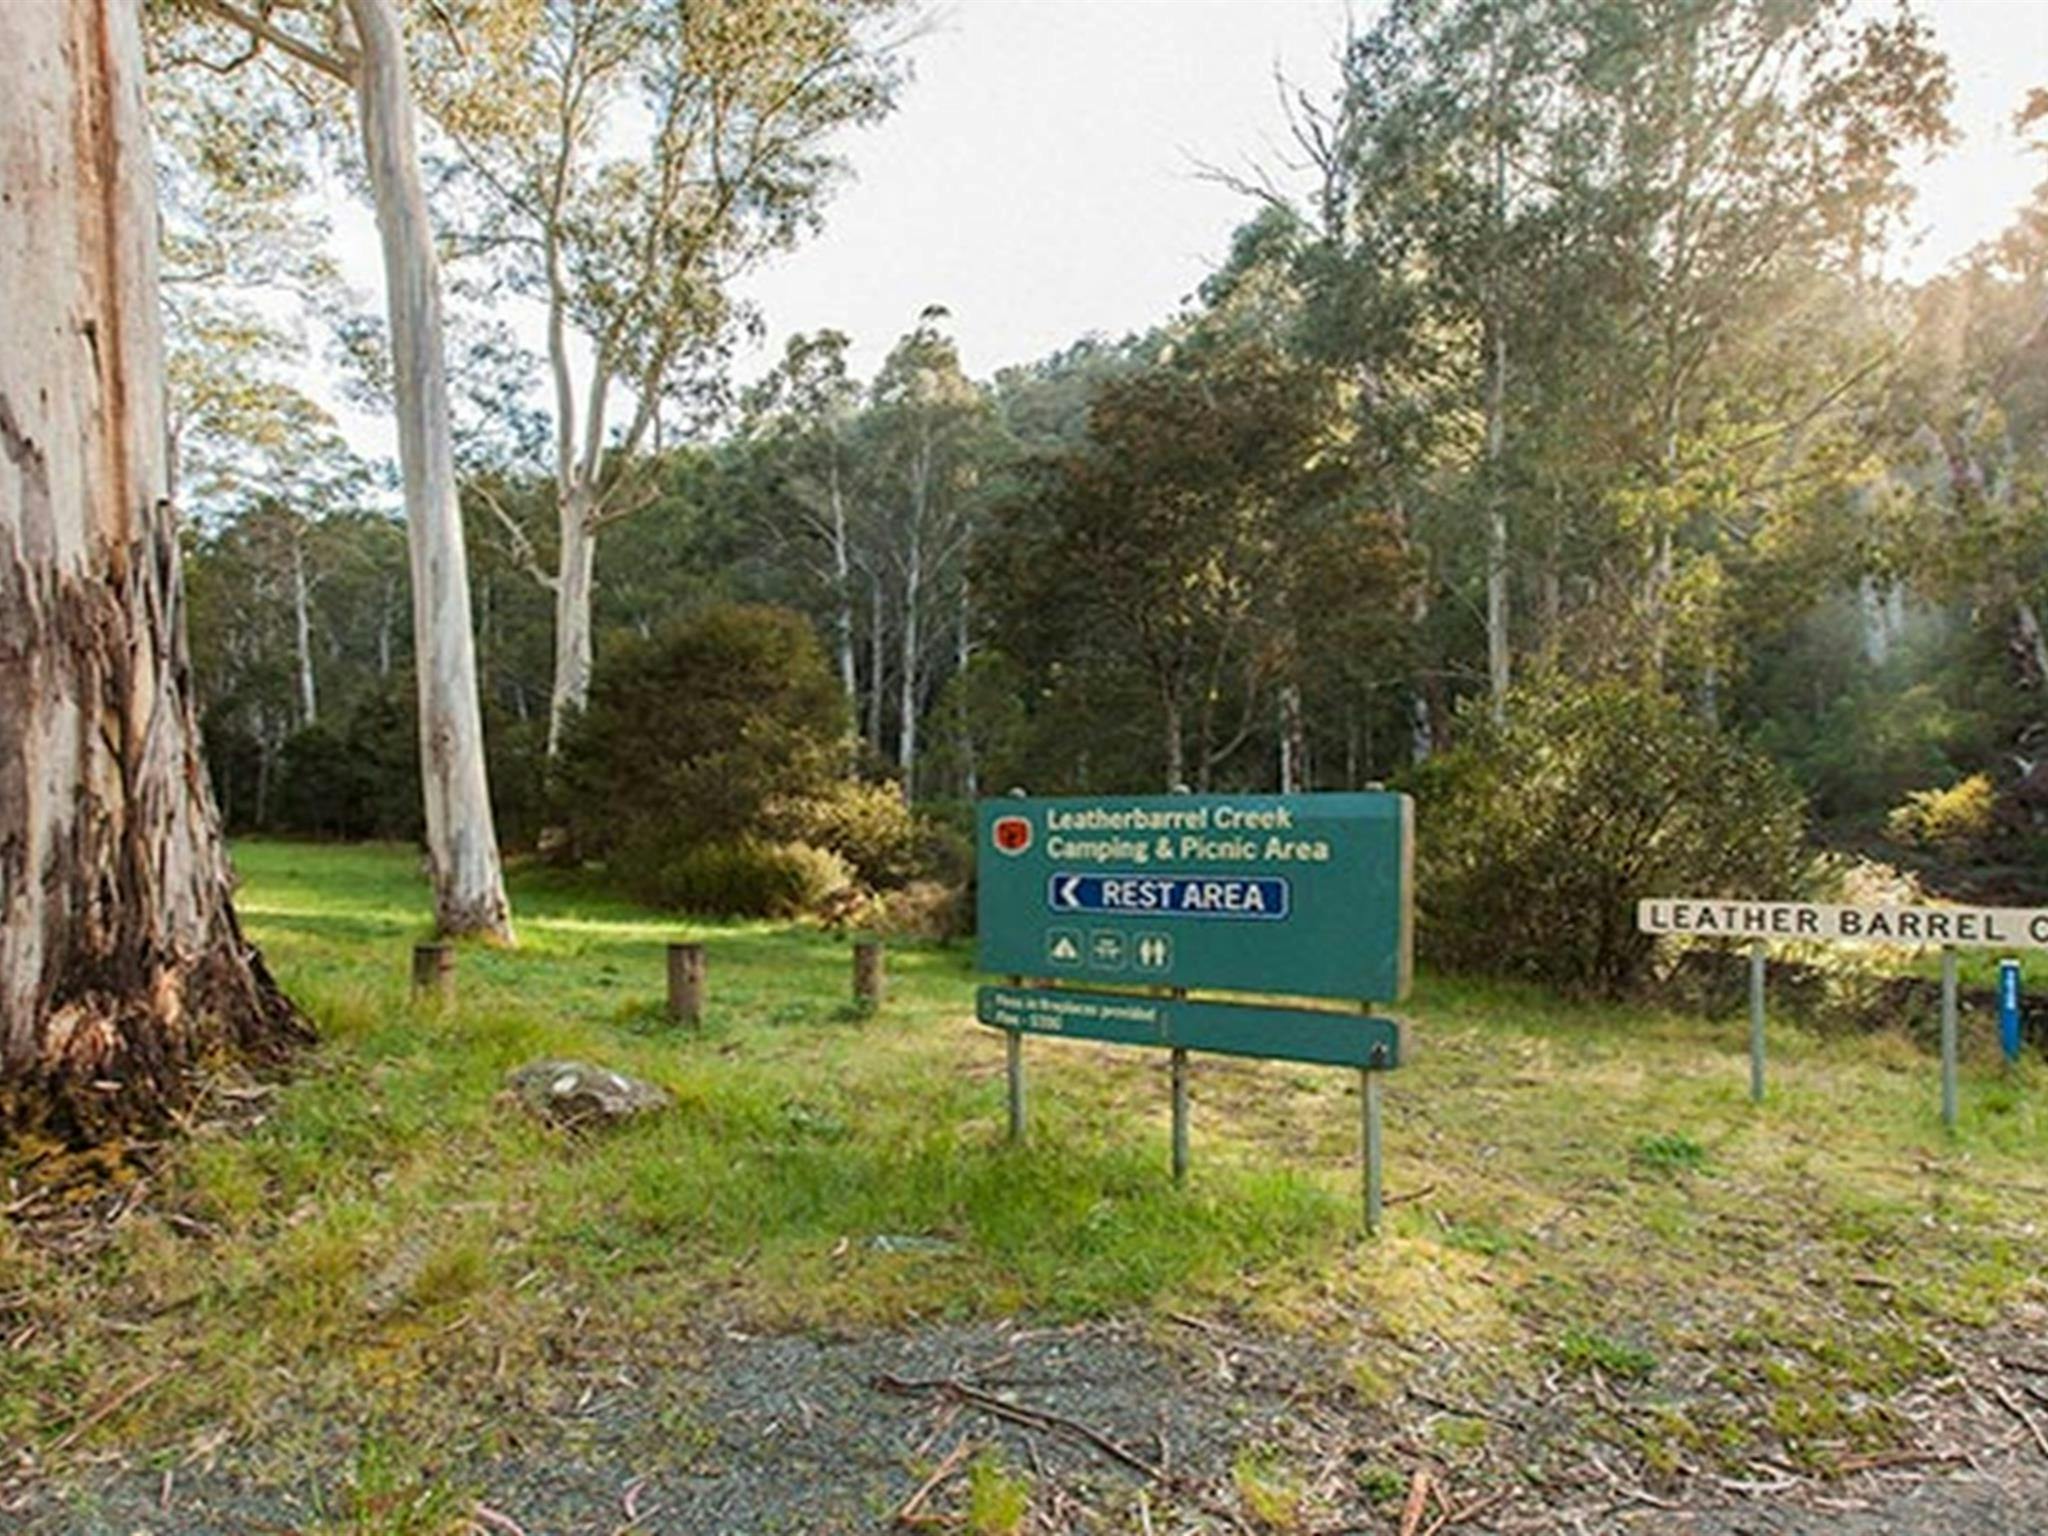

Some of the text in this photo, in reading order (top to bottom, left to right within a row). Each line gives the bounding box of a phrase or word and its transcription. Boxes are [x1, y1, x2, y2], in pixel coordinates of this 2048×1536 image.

[1046, 805, 1293, 830] Leatherbarrel Creek
[1046, 835, 1329, 863] Camping & Picnic Area
[1102, 880, 1266, 912] REST AREA
[1651, 904, 1819, 933] LEATHER
[1839, 910, 2007, 942] BARREL
